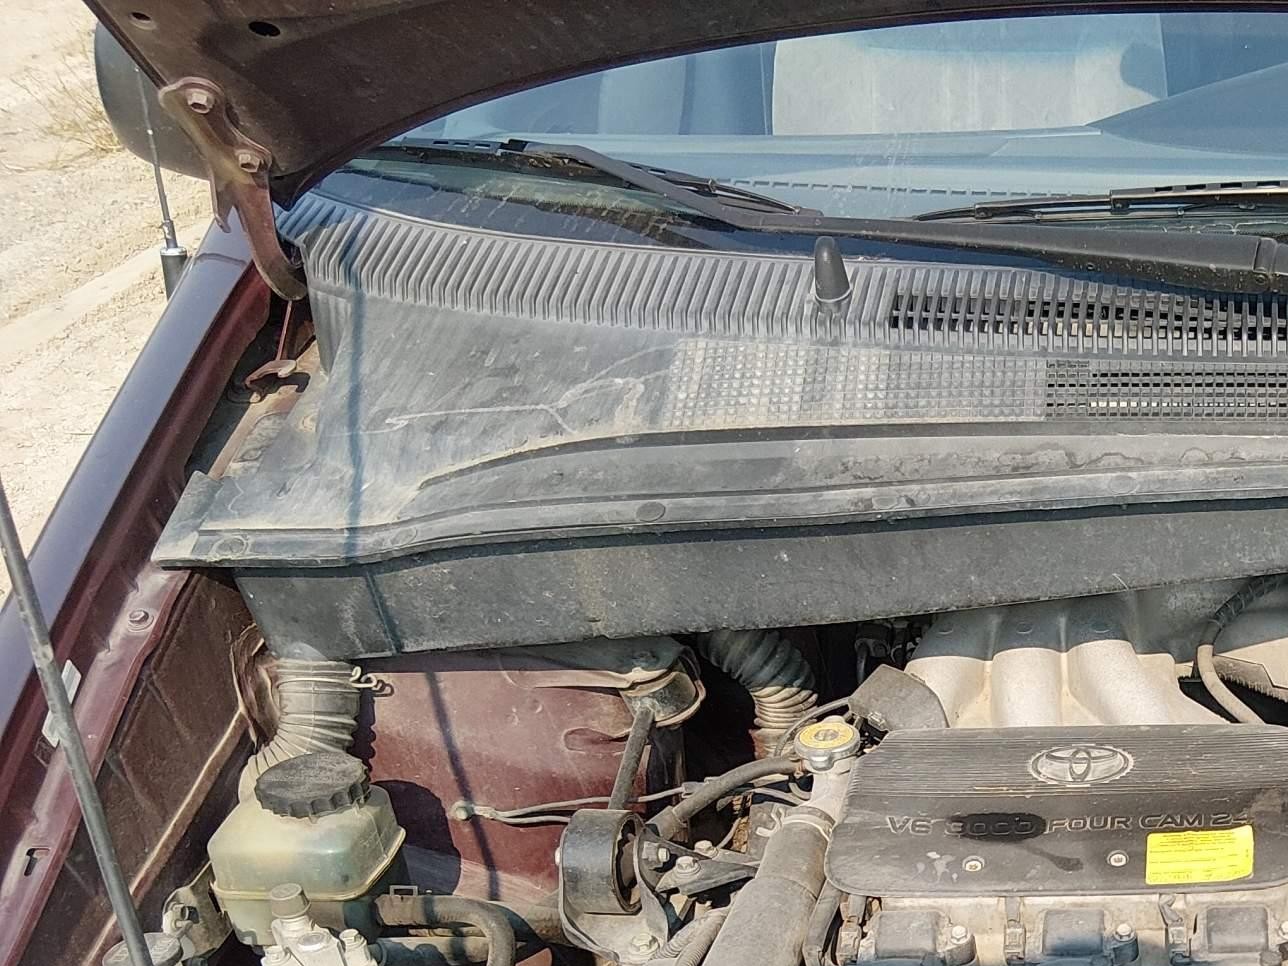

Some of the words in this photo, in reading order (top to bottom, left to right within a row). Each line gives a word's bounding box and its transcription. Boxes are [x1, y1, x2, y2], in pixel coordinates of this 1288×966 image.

[885, 815, 932, 836] V6
[1045, 815, 1132, 833] FOUR
[1139, 813, 1205, 830] CAM
